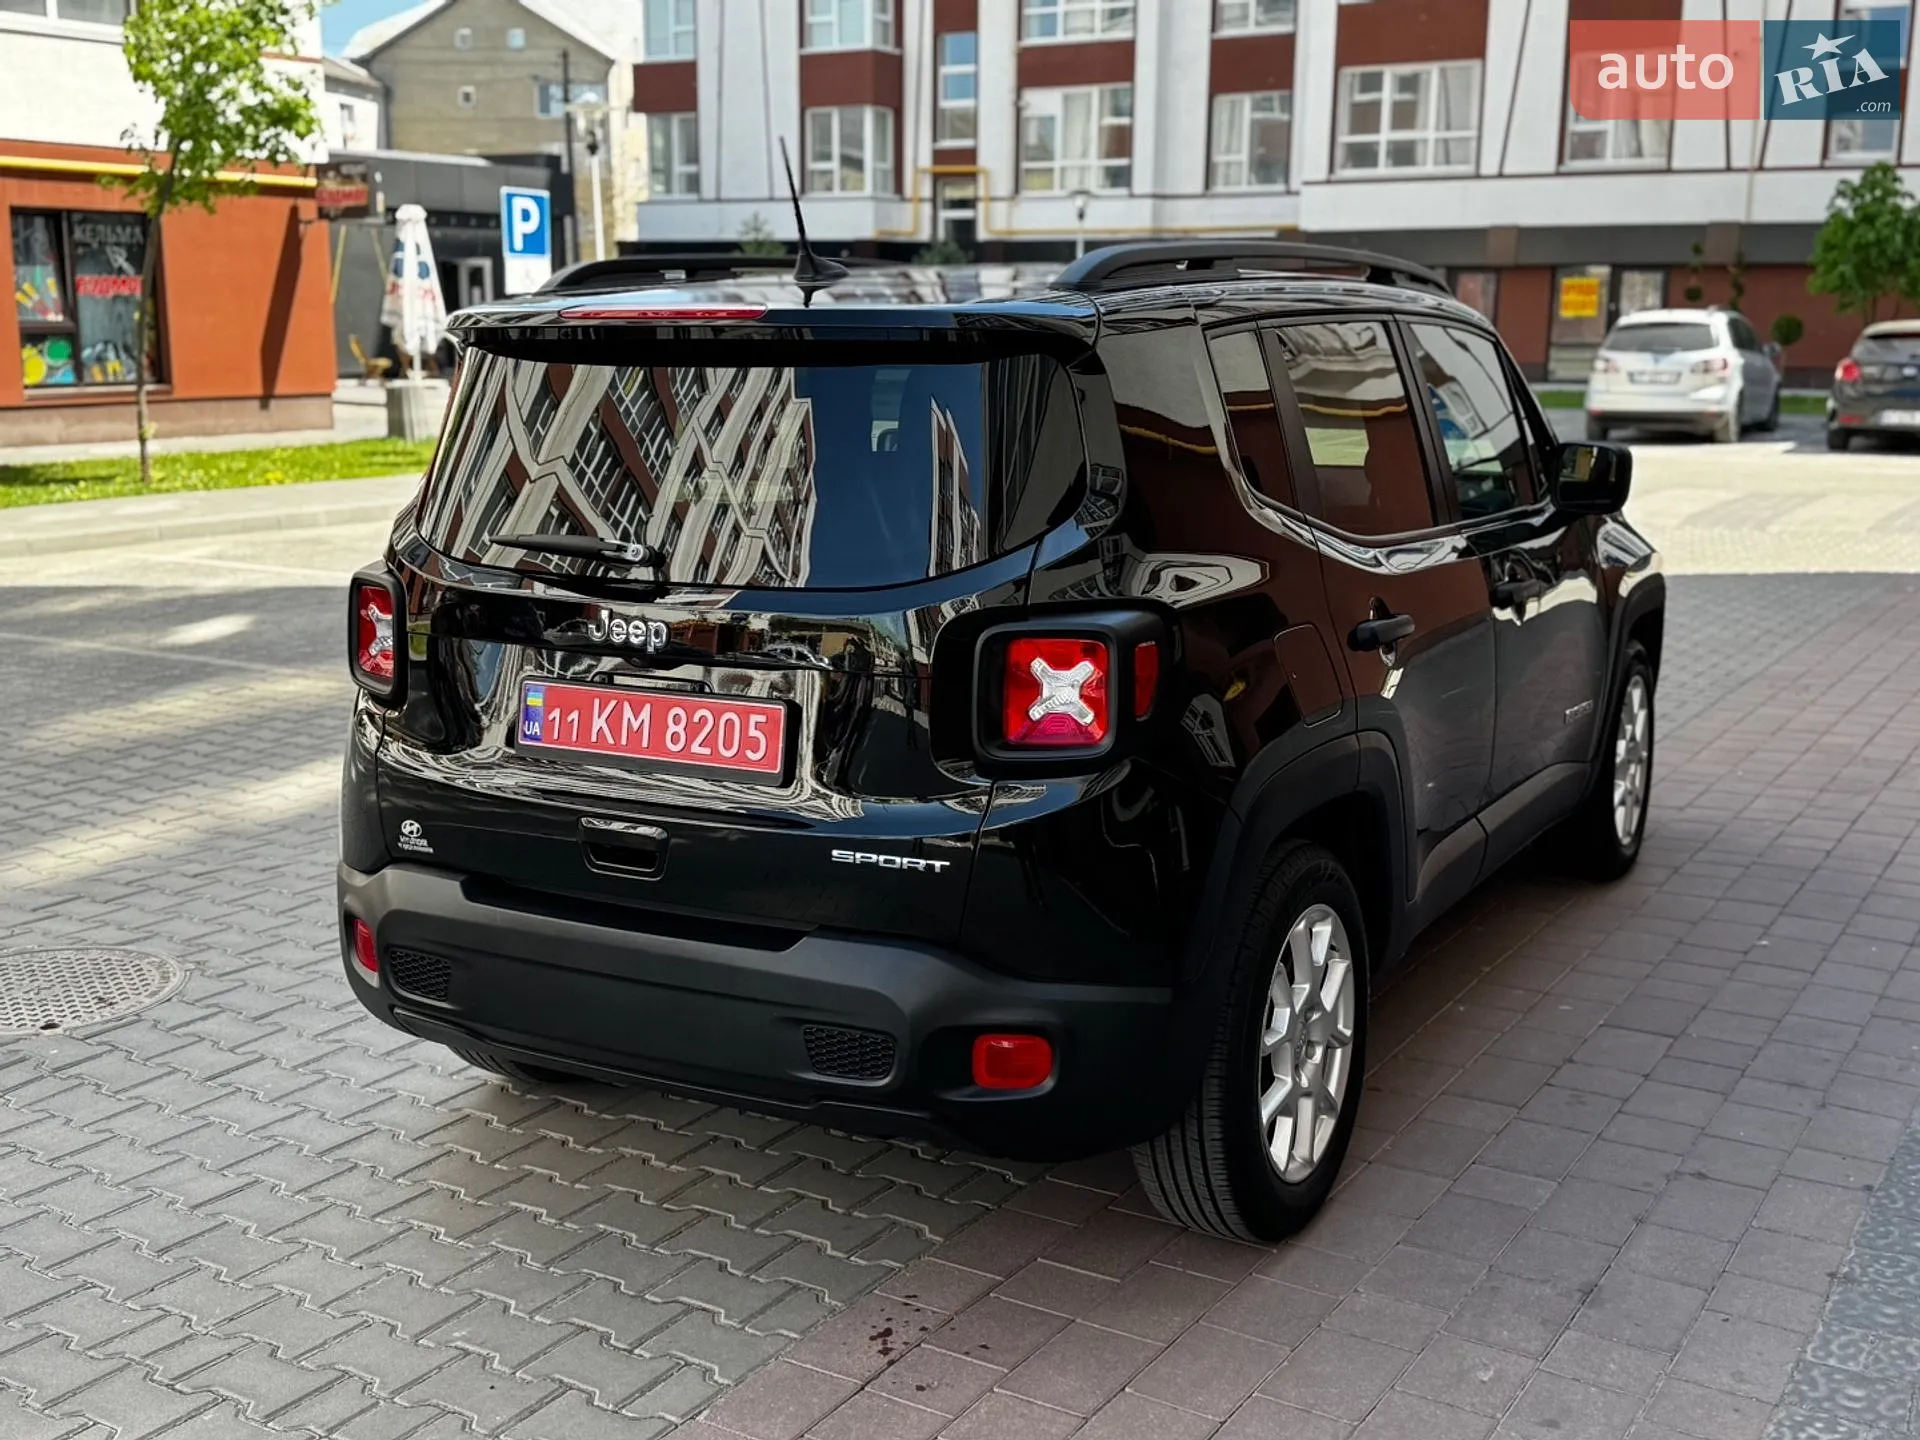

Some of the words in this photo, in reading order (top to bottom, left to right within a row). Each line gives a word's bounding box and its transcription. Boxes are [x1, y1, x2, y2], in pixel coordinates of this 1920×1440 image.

[511, 195, 541, 253] P
[587, 608, 668, 655] Jeep
[523, 720, 541, 737] UA
[547, 706, 580, 743] 11
[590, 697, 652, 749] KM
[664, 706, 769, 762] 8205
[831, 848, 951, 873] SPORT
